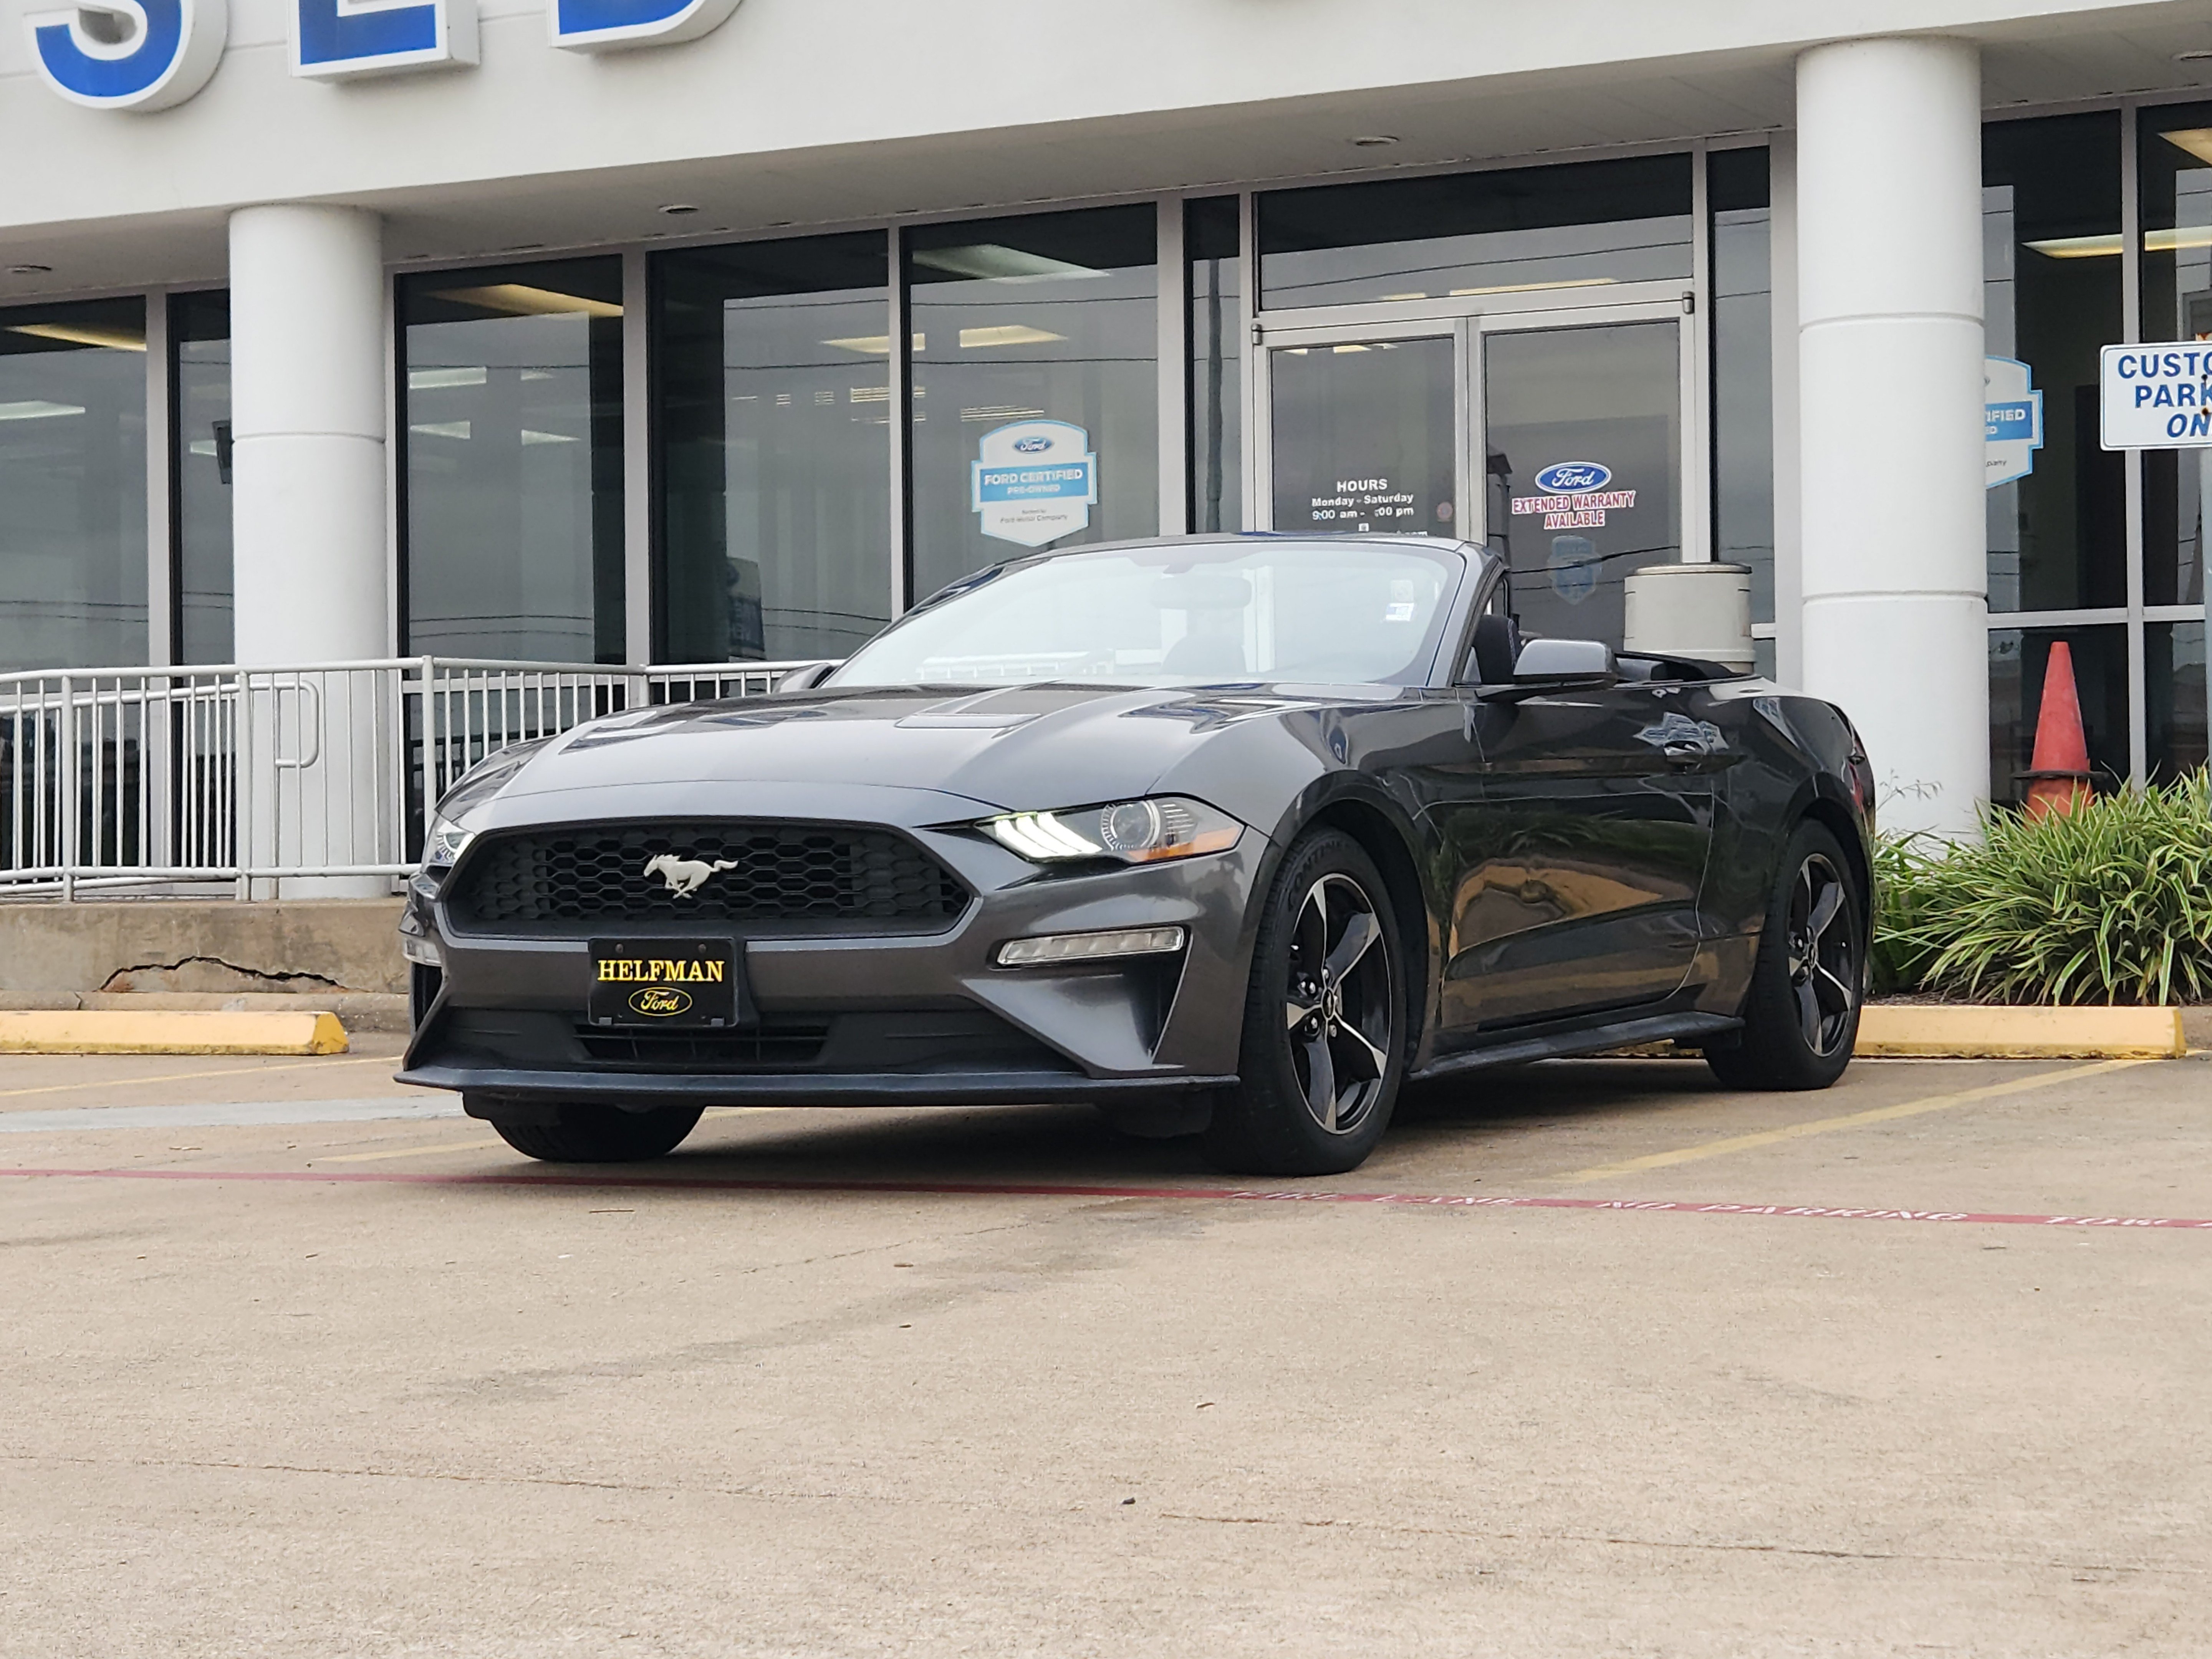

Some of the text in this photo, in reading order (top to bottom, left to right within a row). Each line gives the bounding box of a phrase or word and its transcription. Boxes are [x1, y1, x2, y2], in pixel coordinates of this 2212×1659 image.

[1985, 409, 2026, 422] IFIED
[2167, 412, 2212, 437] ON
[984, 468, 1083, 486] FORD CERTIFIED
[1337, 478, 1388, 492] HOURS
[1551, 468, 1595, 487] Ford
[1312, 497, 1354, 507] Monday
[1364, 493, 1414, 504] Saturday
[1512, 490, 1636, 514] EXTENDED WARRANTY
[1339, 510, 1358, 519] am
[1396, 507, 1414, 517] pm
[1544, 511, 1605, 529] AVAILABLE
[598, 960, 725, 982] HELFMAN
[640, 990, 680, 1011] Ford
[1697, 1203, 1969, 1220] PARKING
